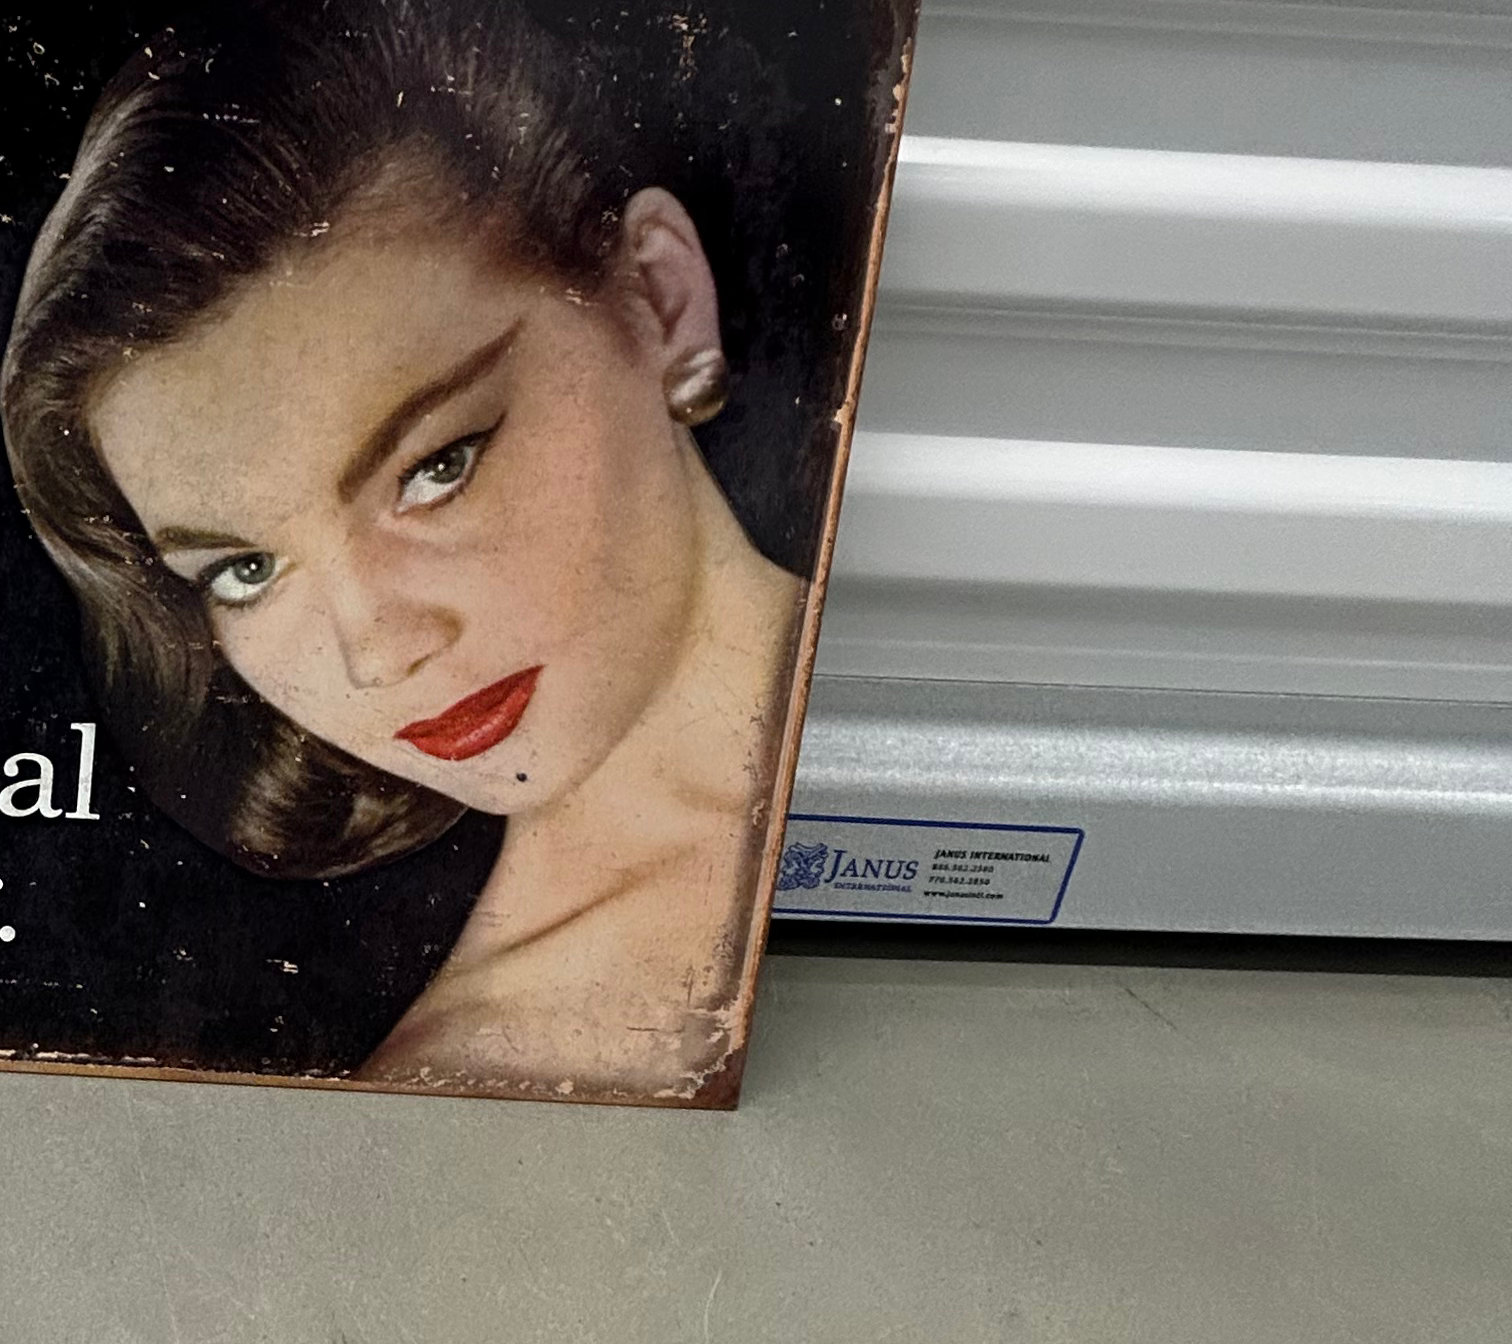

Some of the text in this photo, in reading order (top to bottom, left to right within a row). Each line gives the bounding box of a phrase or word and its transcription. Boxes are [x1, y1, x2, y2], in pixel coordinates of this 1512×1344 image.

[933, 849, 1050, 863] JANUS INTERNATIONAL
[824, 849, 920, 883] JANUS
[834, 882, 912, 893] INTERNATIONAL
